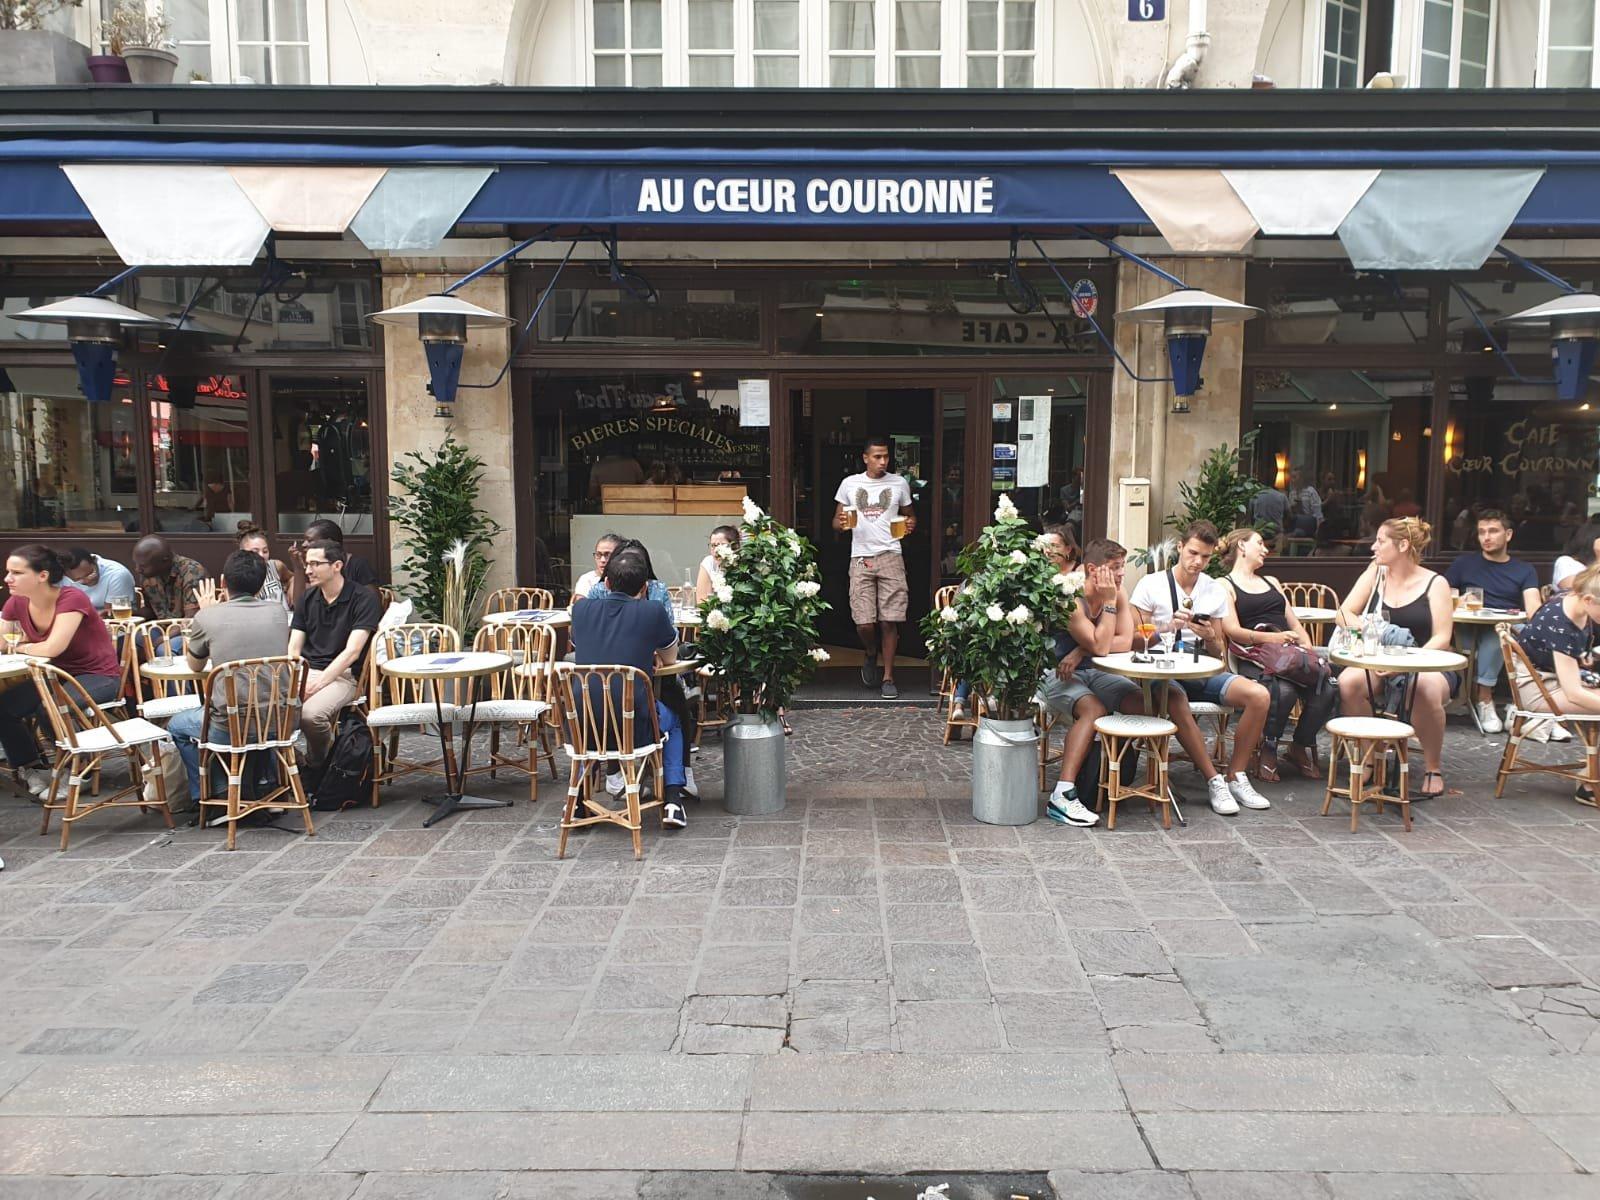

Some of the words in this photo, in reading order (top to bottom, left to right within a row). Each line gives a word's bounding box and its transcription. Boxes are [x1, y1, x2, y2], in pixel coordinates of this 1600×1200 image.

[1139, 0, 1154, 19] 6
[637, 178, 684, 213] AU
[693, 178, 797, 213] CŒUR
[806, 176, 994, 214] COURONNÉ
[571, 417, 640, 450] BIERES
[646, 417, 735, 453] SPECIALES
